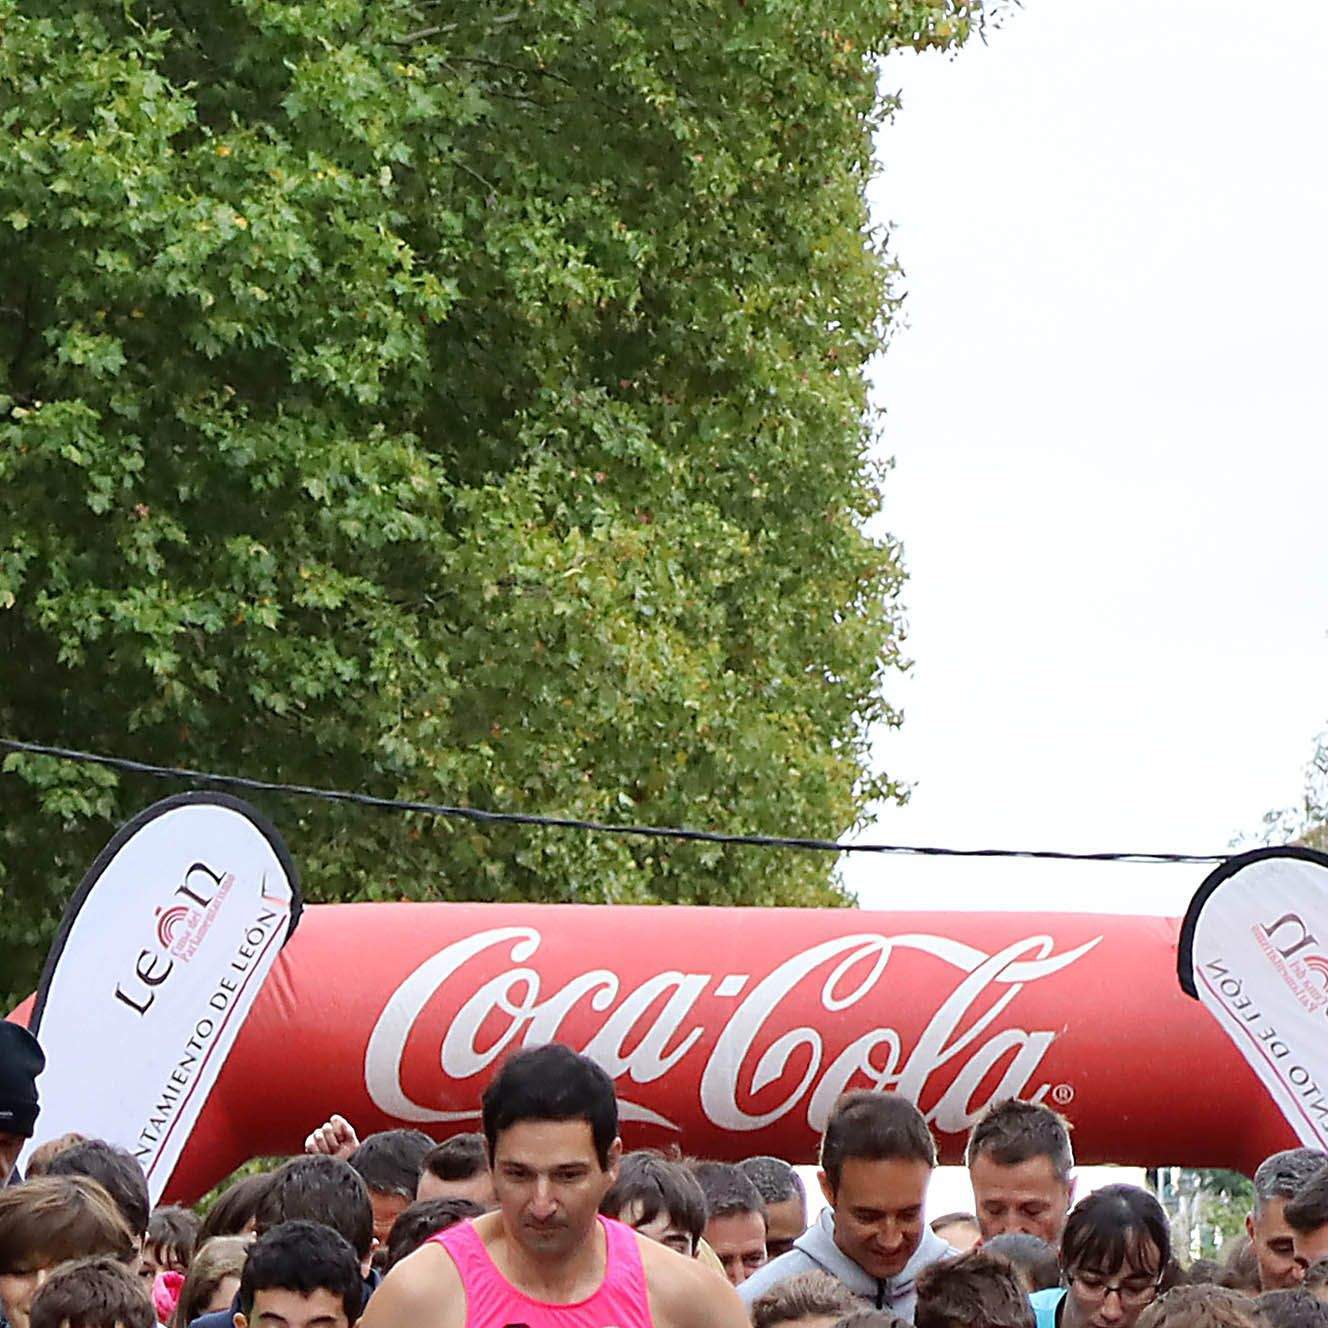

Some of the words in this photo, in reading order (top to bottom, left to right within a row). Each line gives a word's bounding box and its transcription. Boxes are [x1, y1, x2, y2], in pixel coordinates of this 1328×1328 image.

[209, 976, 238, 1012] DE
[231, 907, 277, 973] LEÓN
[364, 926, 1104, 1134] Coca-Cola
